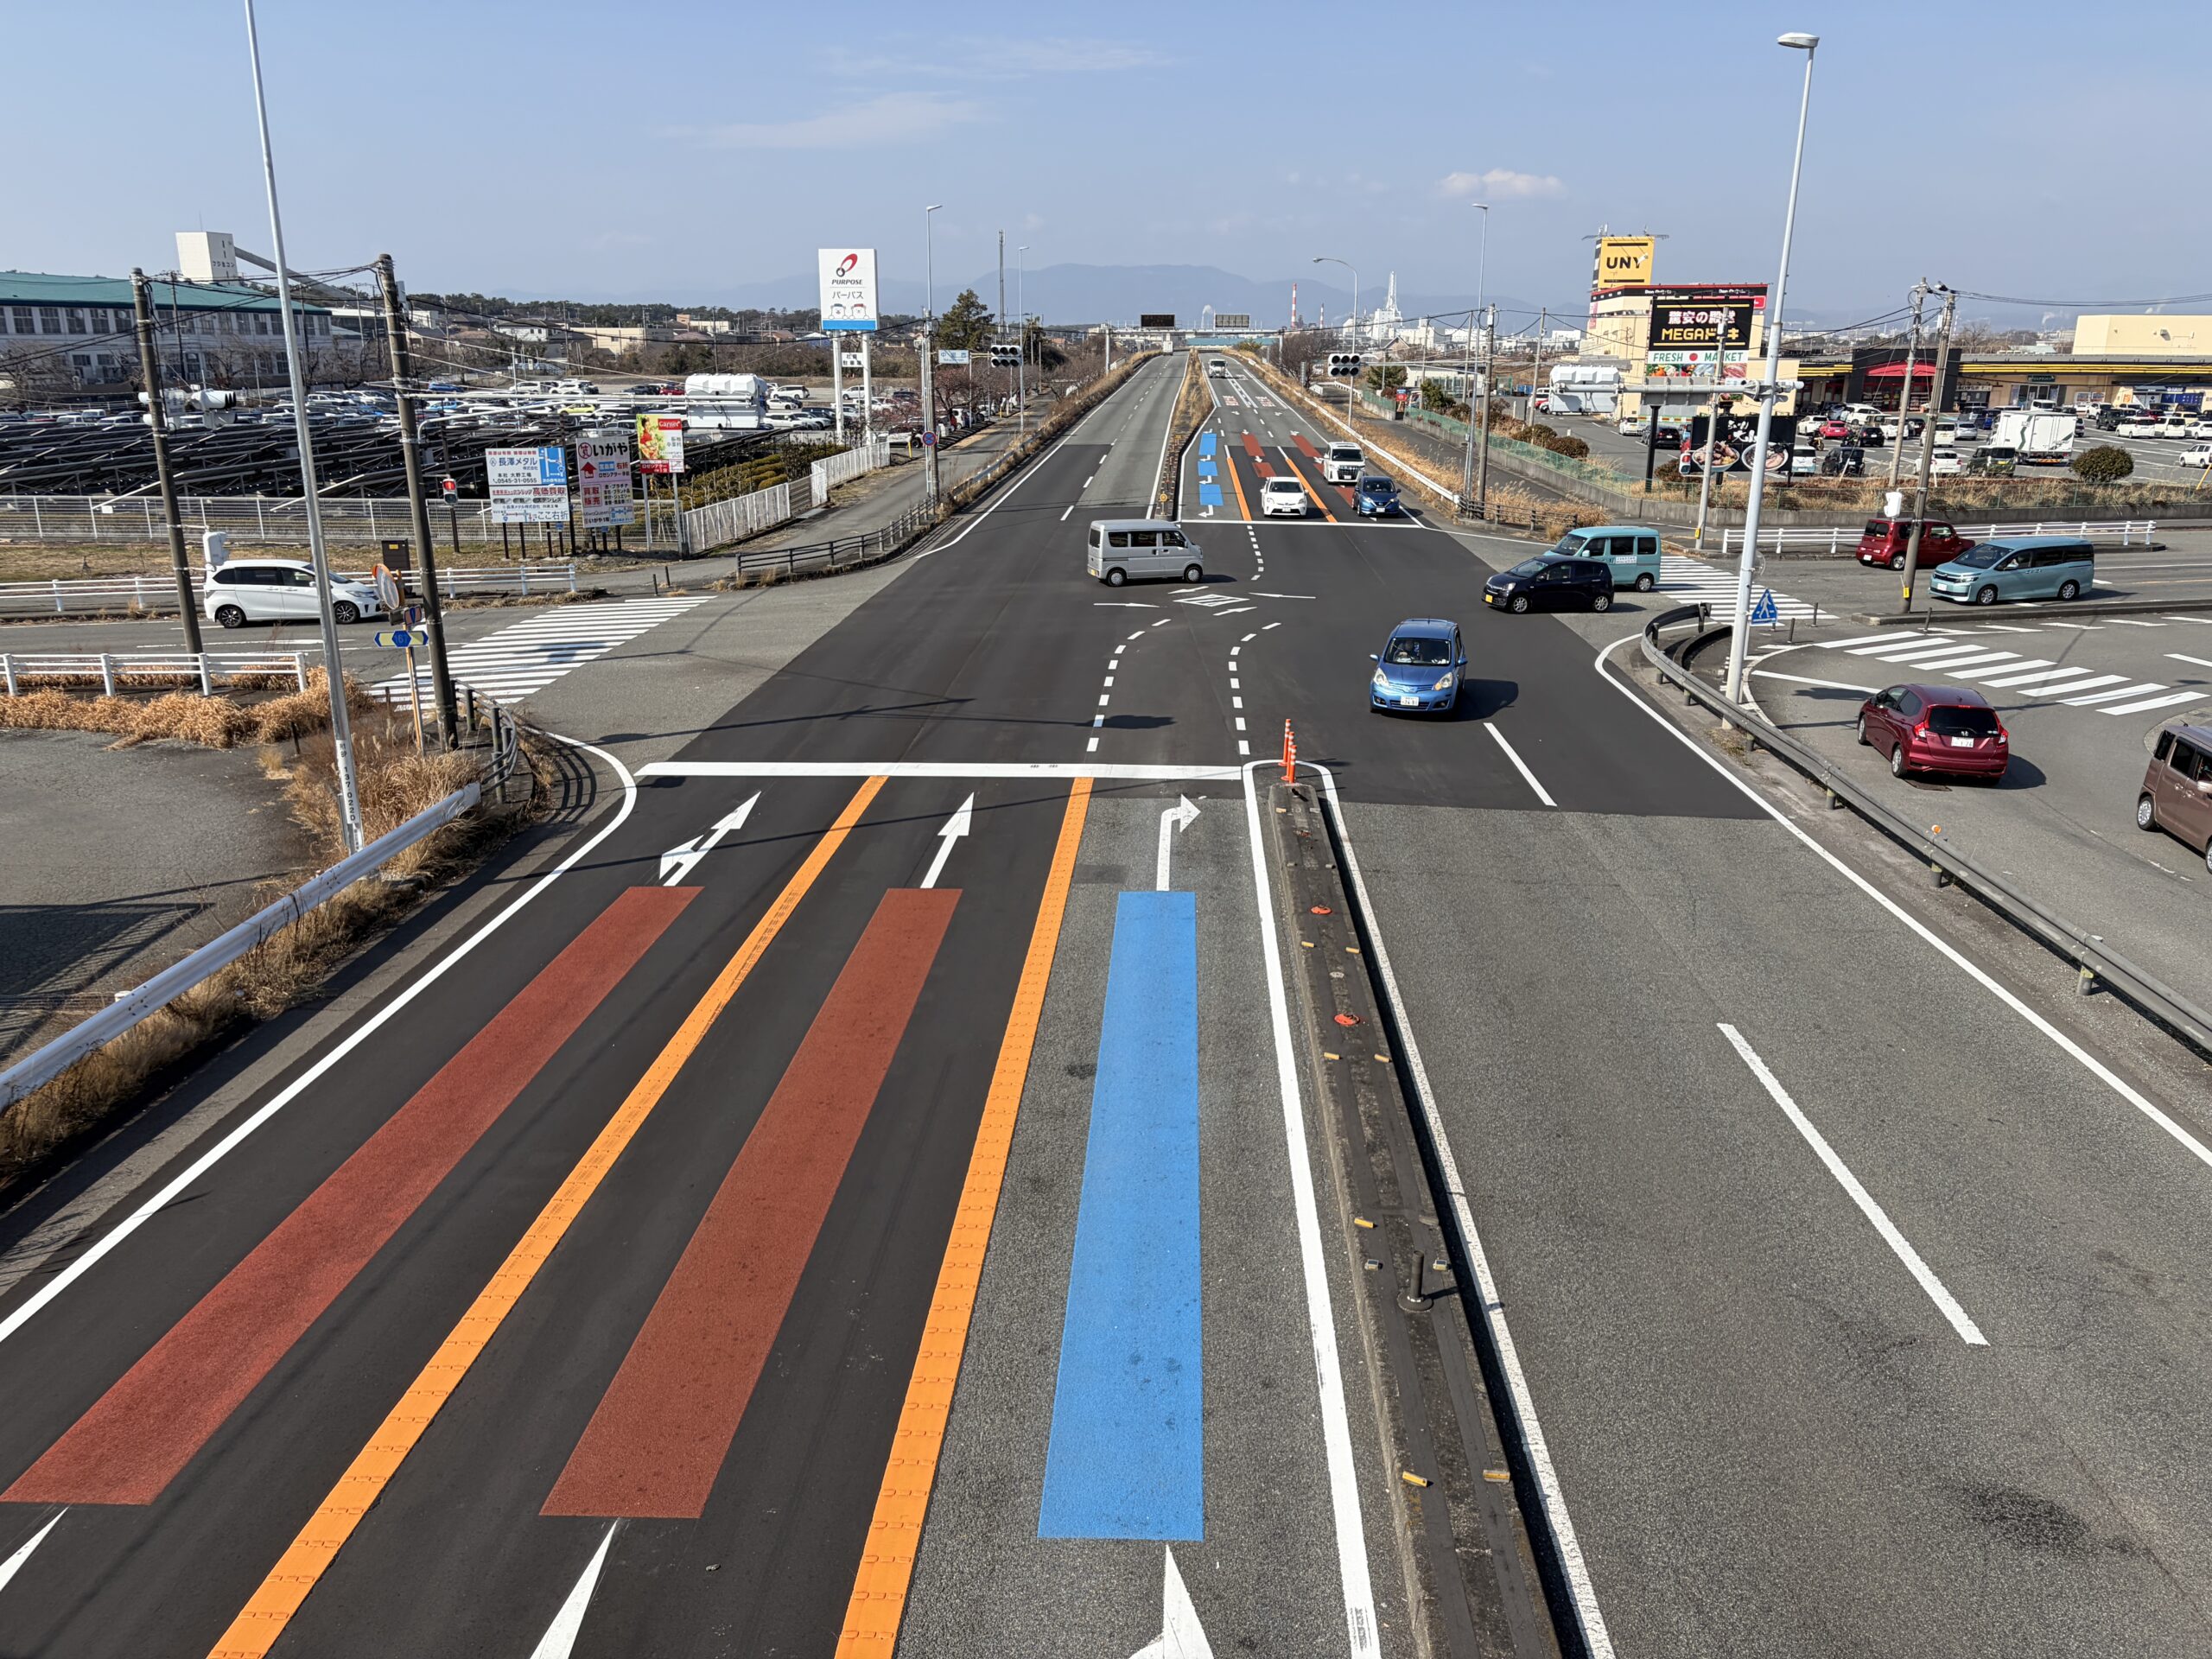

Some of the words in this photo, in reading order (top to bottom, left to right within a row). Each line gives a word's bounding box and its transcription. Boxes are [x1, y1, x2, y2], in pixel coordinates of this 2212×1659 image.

[1606, 256, 1640, 270] UNY
[1661, 327, 1739, 340] MEGAドキ
[1653, 353, 1683, 362] FRESH
[1704, 352, 1744, 362] MAKET
[593, 442, 628, 457] いがや
[499, 458, 537, 467] 長澤メタル
[583, 486, 600, 495] 買取
[537, 510, 569, 520] ここ右折
